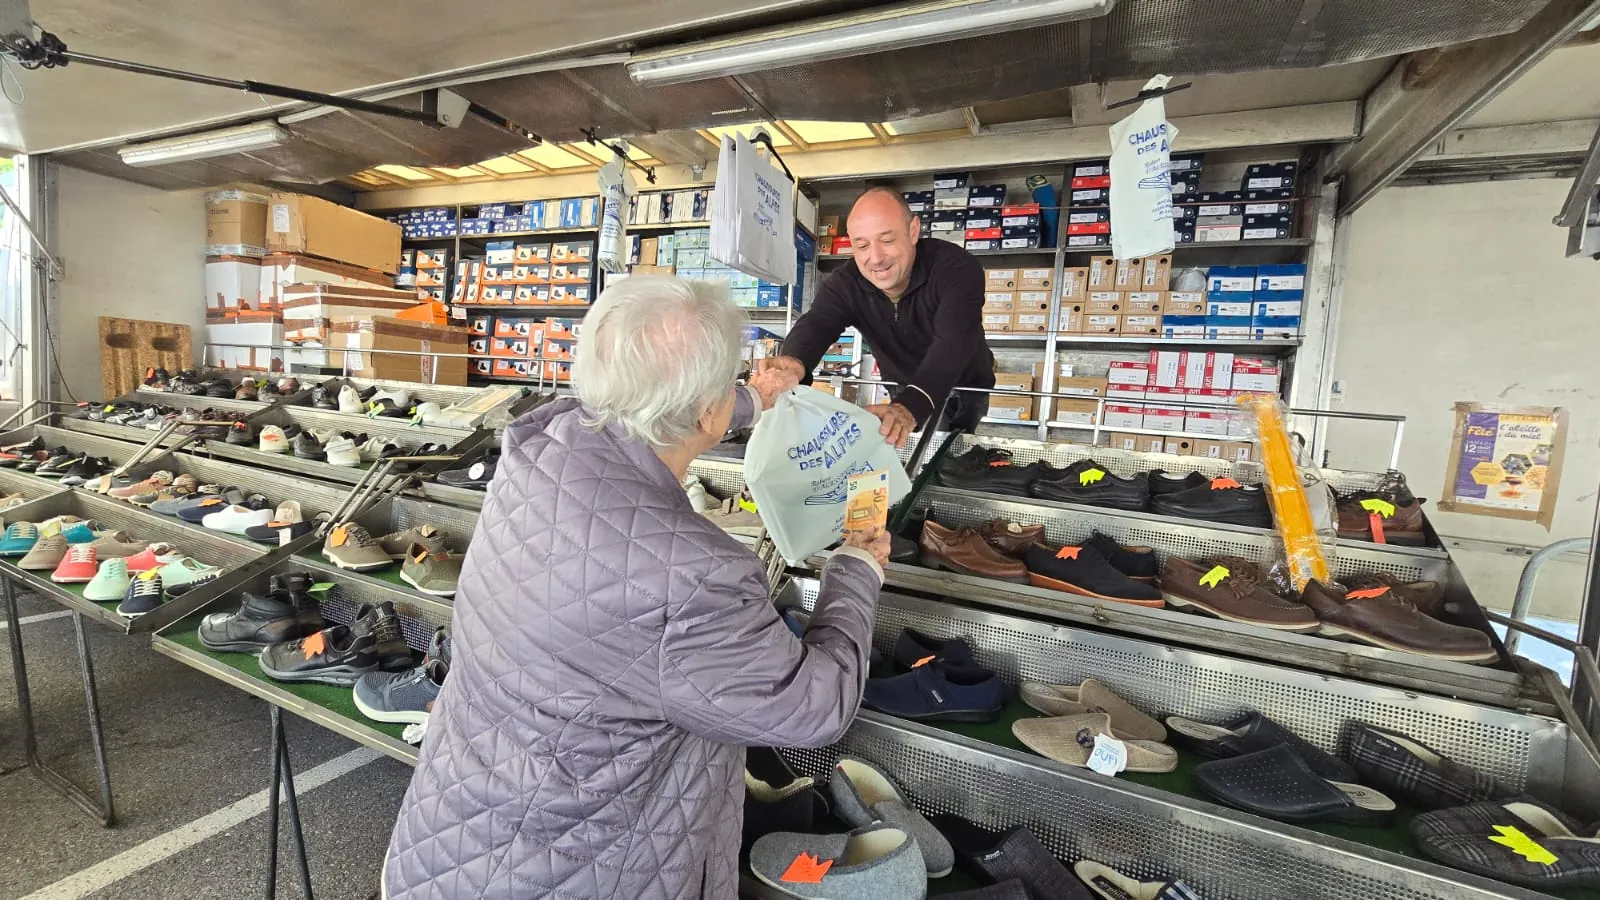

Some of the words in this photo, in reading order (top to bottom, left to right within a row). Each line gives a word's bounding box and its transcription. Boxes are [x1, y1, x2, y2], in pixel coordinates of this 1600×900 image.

[1137, 143, 1157, 156] DES
[787, 410, 850, 459] CHAUSSURES
[800, 457, 823, 470] DES
[824, 423, 862, 469] ALPES
[1464, 444, 1477, 453] 12
[849, 481, 857, 491] 50
[873, 487, 886, 502] 50
